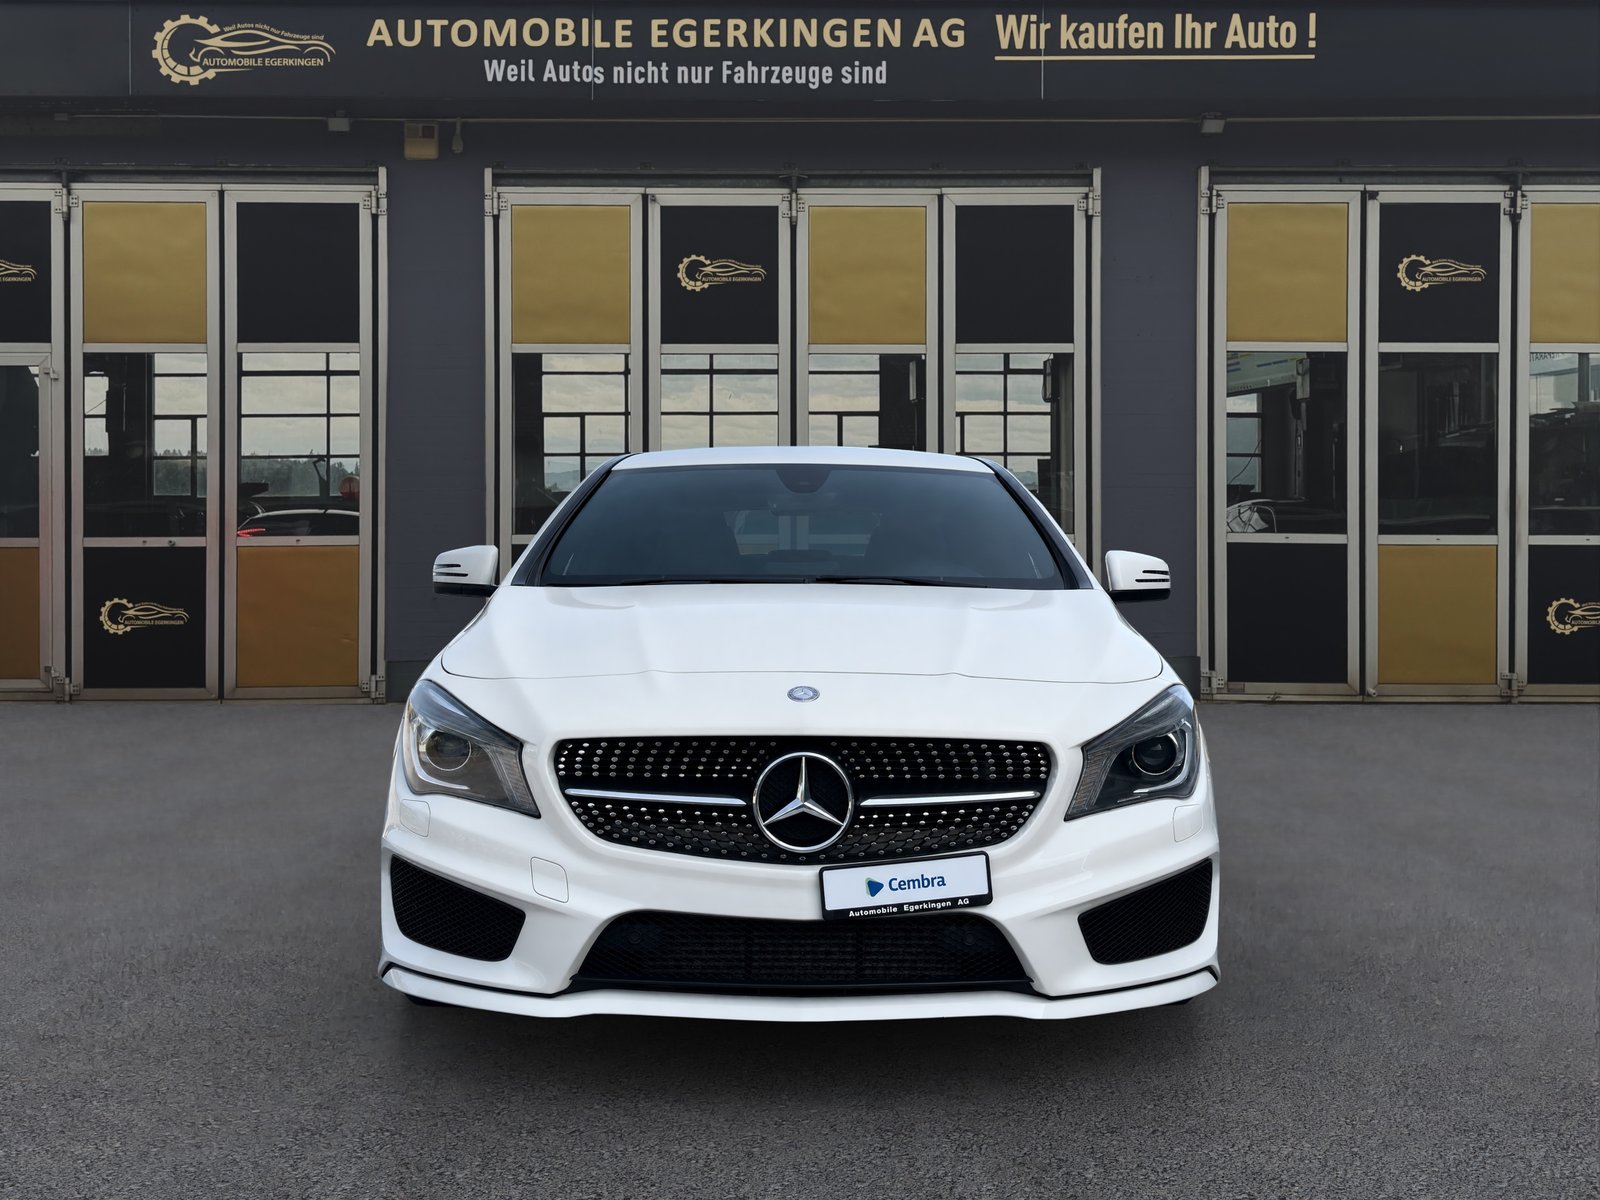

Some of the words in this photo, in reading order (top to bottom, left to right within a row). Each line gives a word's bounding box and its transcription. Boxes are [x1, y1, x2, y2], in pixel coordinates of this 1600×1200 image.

[366, 17, 633, 48] AUTOMOBILE
[650, 18, 901, 48] EGERKINGEN
[912, 18, 966, 48] AG
[995, 14, 1052, 50] Wir
[1060, 13, 1164, 49] kaufen
[1174, 13, 1217, 49] Ihr
[1224, 13, 1297, 49] Auto
[202, 57, 263, 67] AUTOMOBILE
[265, 57, 324, 67] EGERKINGEN
[483, 59, 535, 83] Weil
[543, 59, 605, 84] Autos
[612, 61, 669, 84] nicht
[676, 65, 713, 84] nur
[721, 61, 833, 90] Fahrzeuge
[841, 60, 887, 84] sind
[888, 873, 947, 892] Cembra
[848, 906, 898, 918] Automobile
[903, 900, 952, 912] Egerkingen
[957, 898, 970, 906] AG
